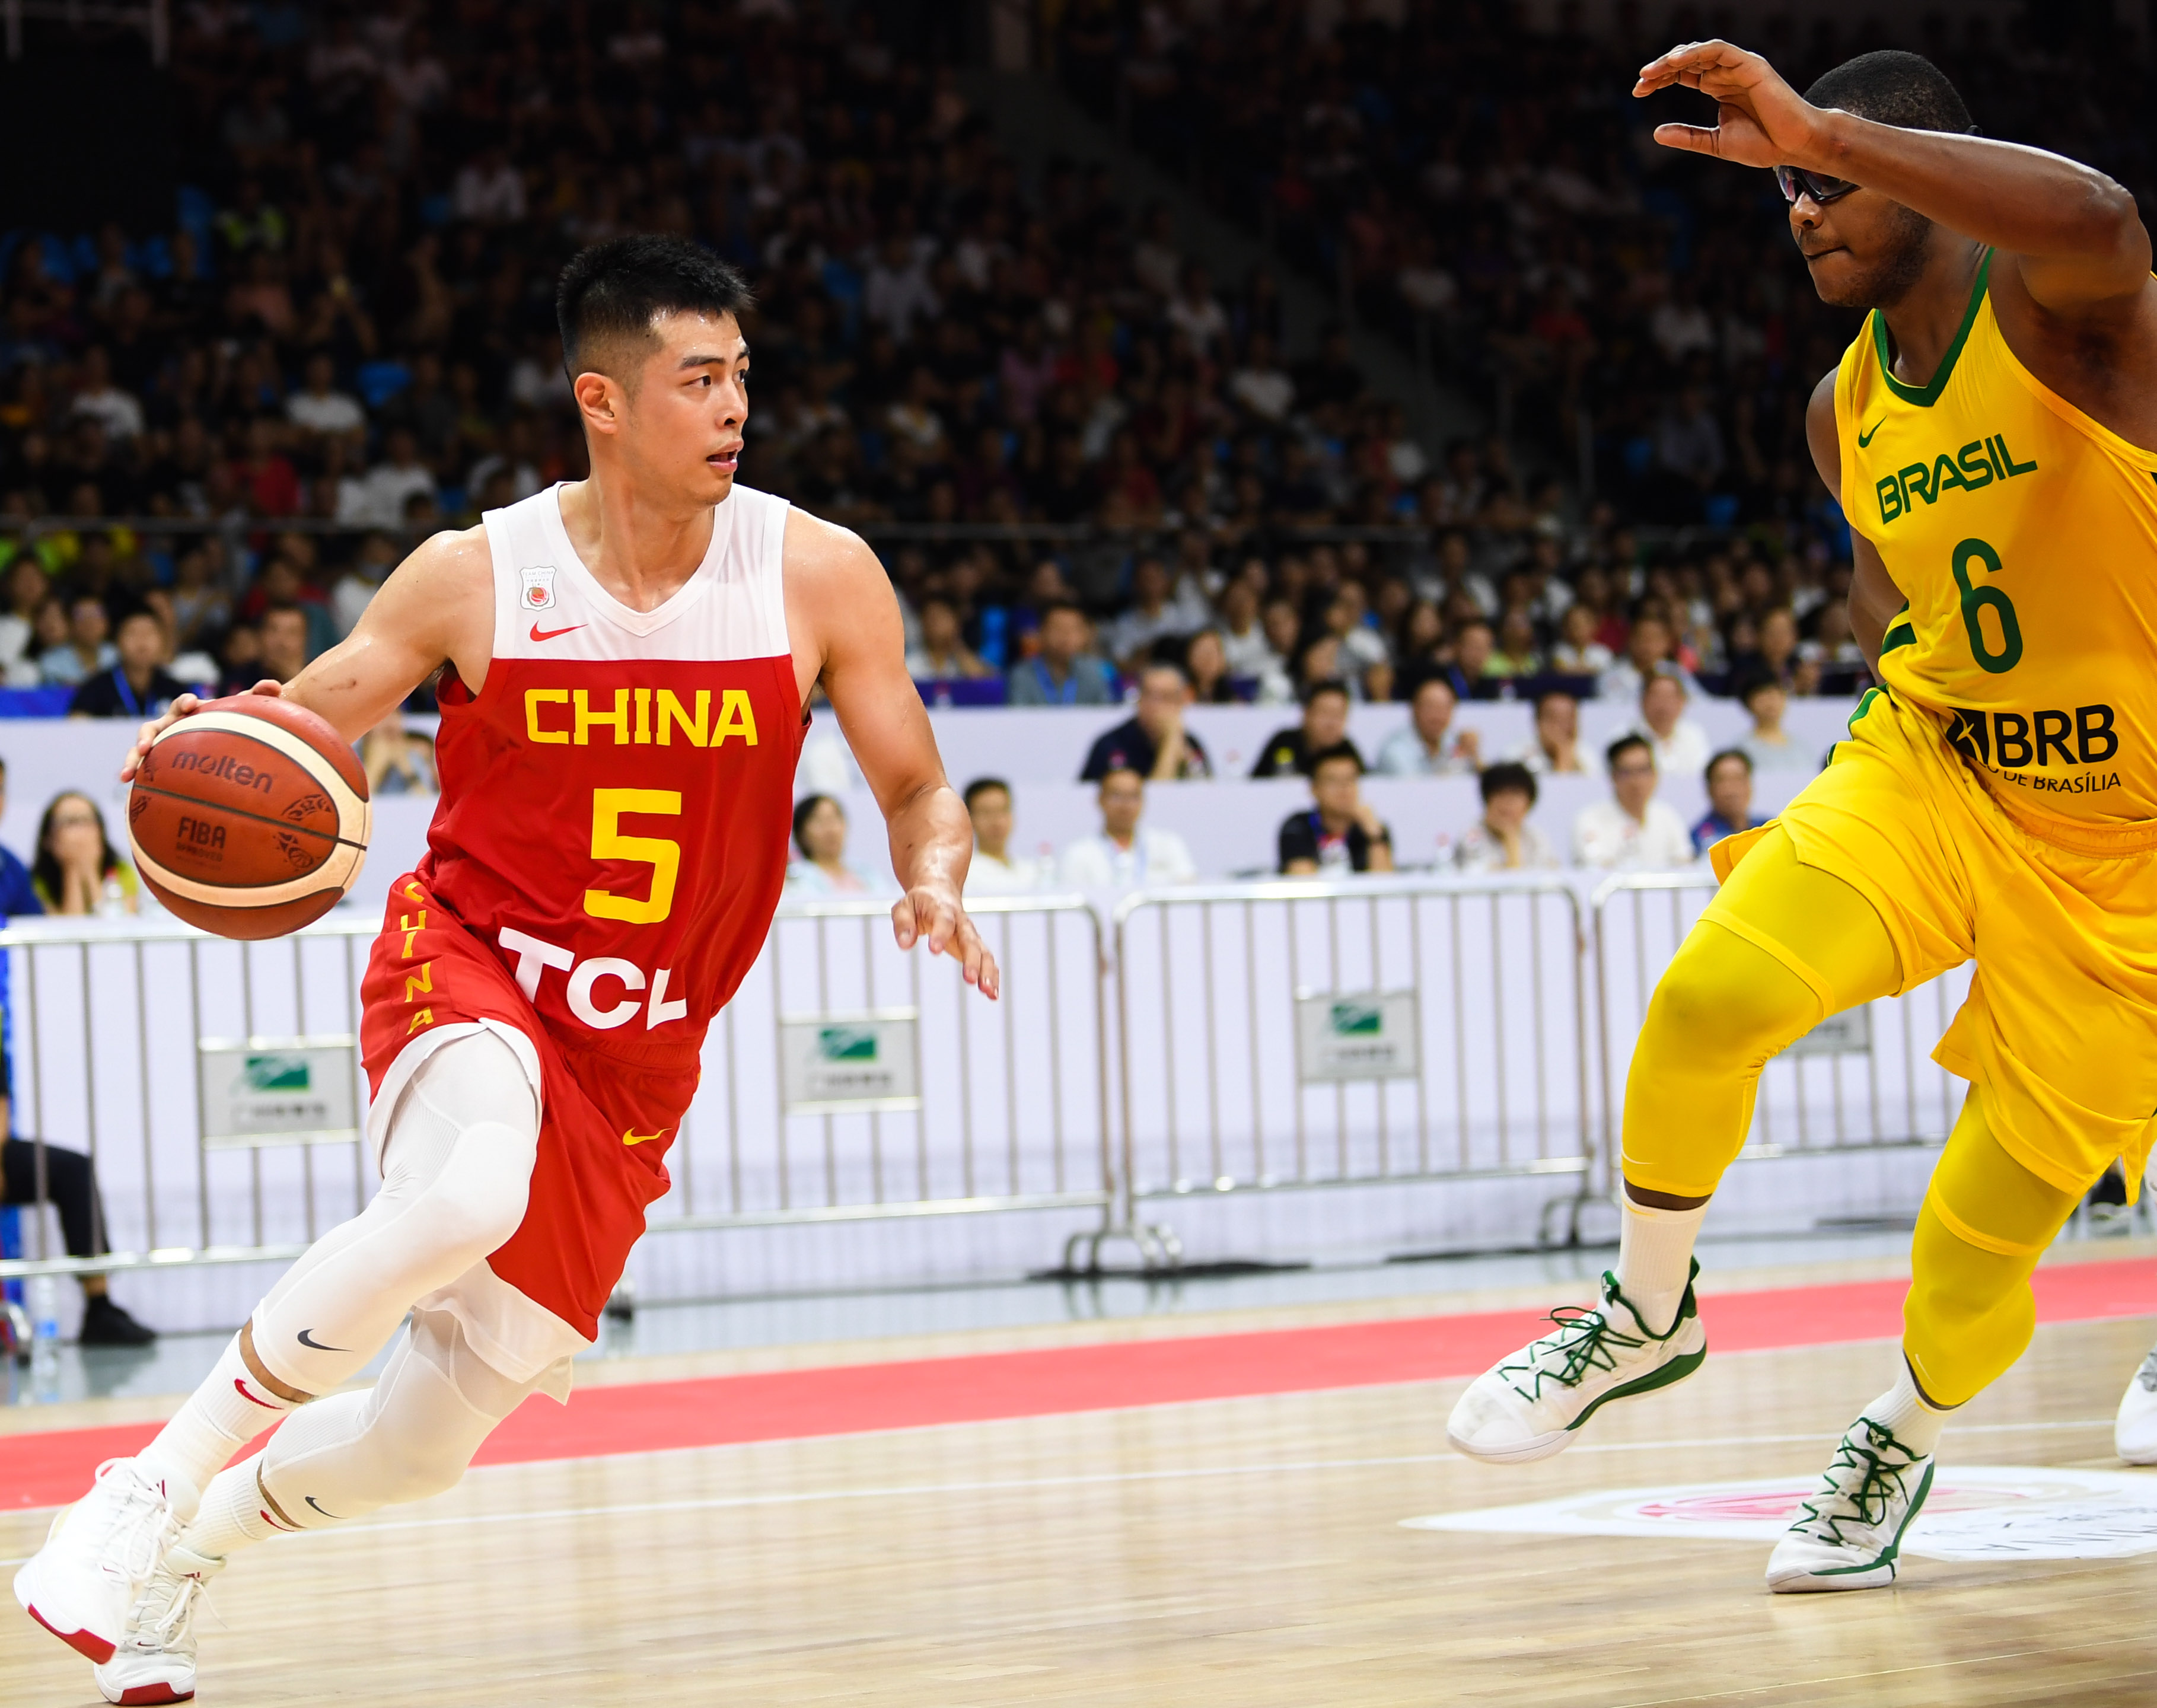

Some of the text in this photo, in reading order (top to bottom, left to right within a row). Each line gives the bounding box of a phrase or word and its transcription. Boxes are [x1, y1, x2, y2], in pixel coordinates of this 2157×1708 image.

[1876, 434, 2038, 525] BRASIL
[1951, 538, 2024, 674] 6
[524, 688, 759, 748] CHINA
[1993, 704, 2118, 767] BRB
[172, 751, 273, 794] molten
[2033, 771, 2121, 794] BRASÍLIA
[178, 816, 226, 849] FIBA
[583, 788, 682, 925] 5
[498, 926, 687, 1030] TCL
